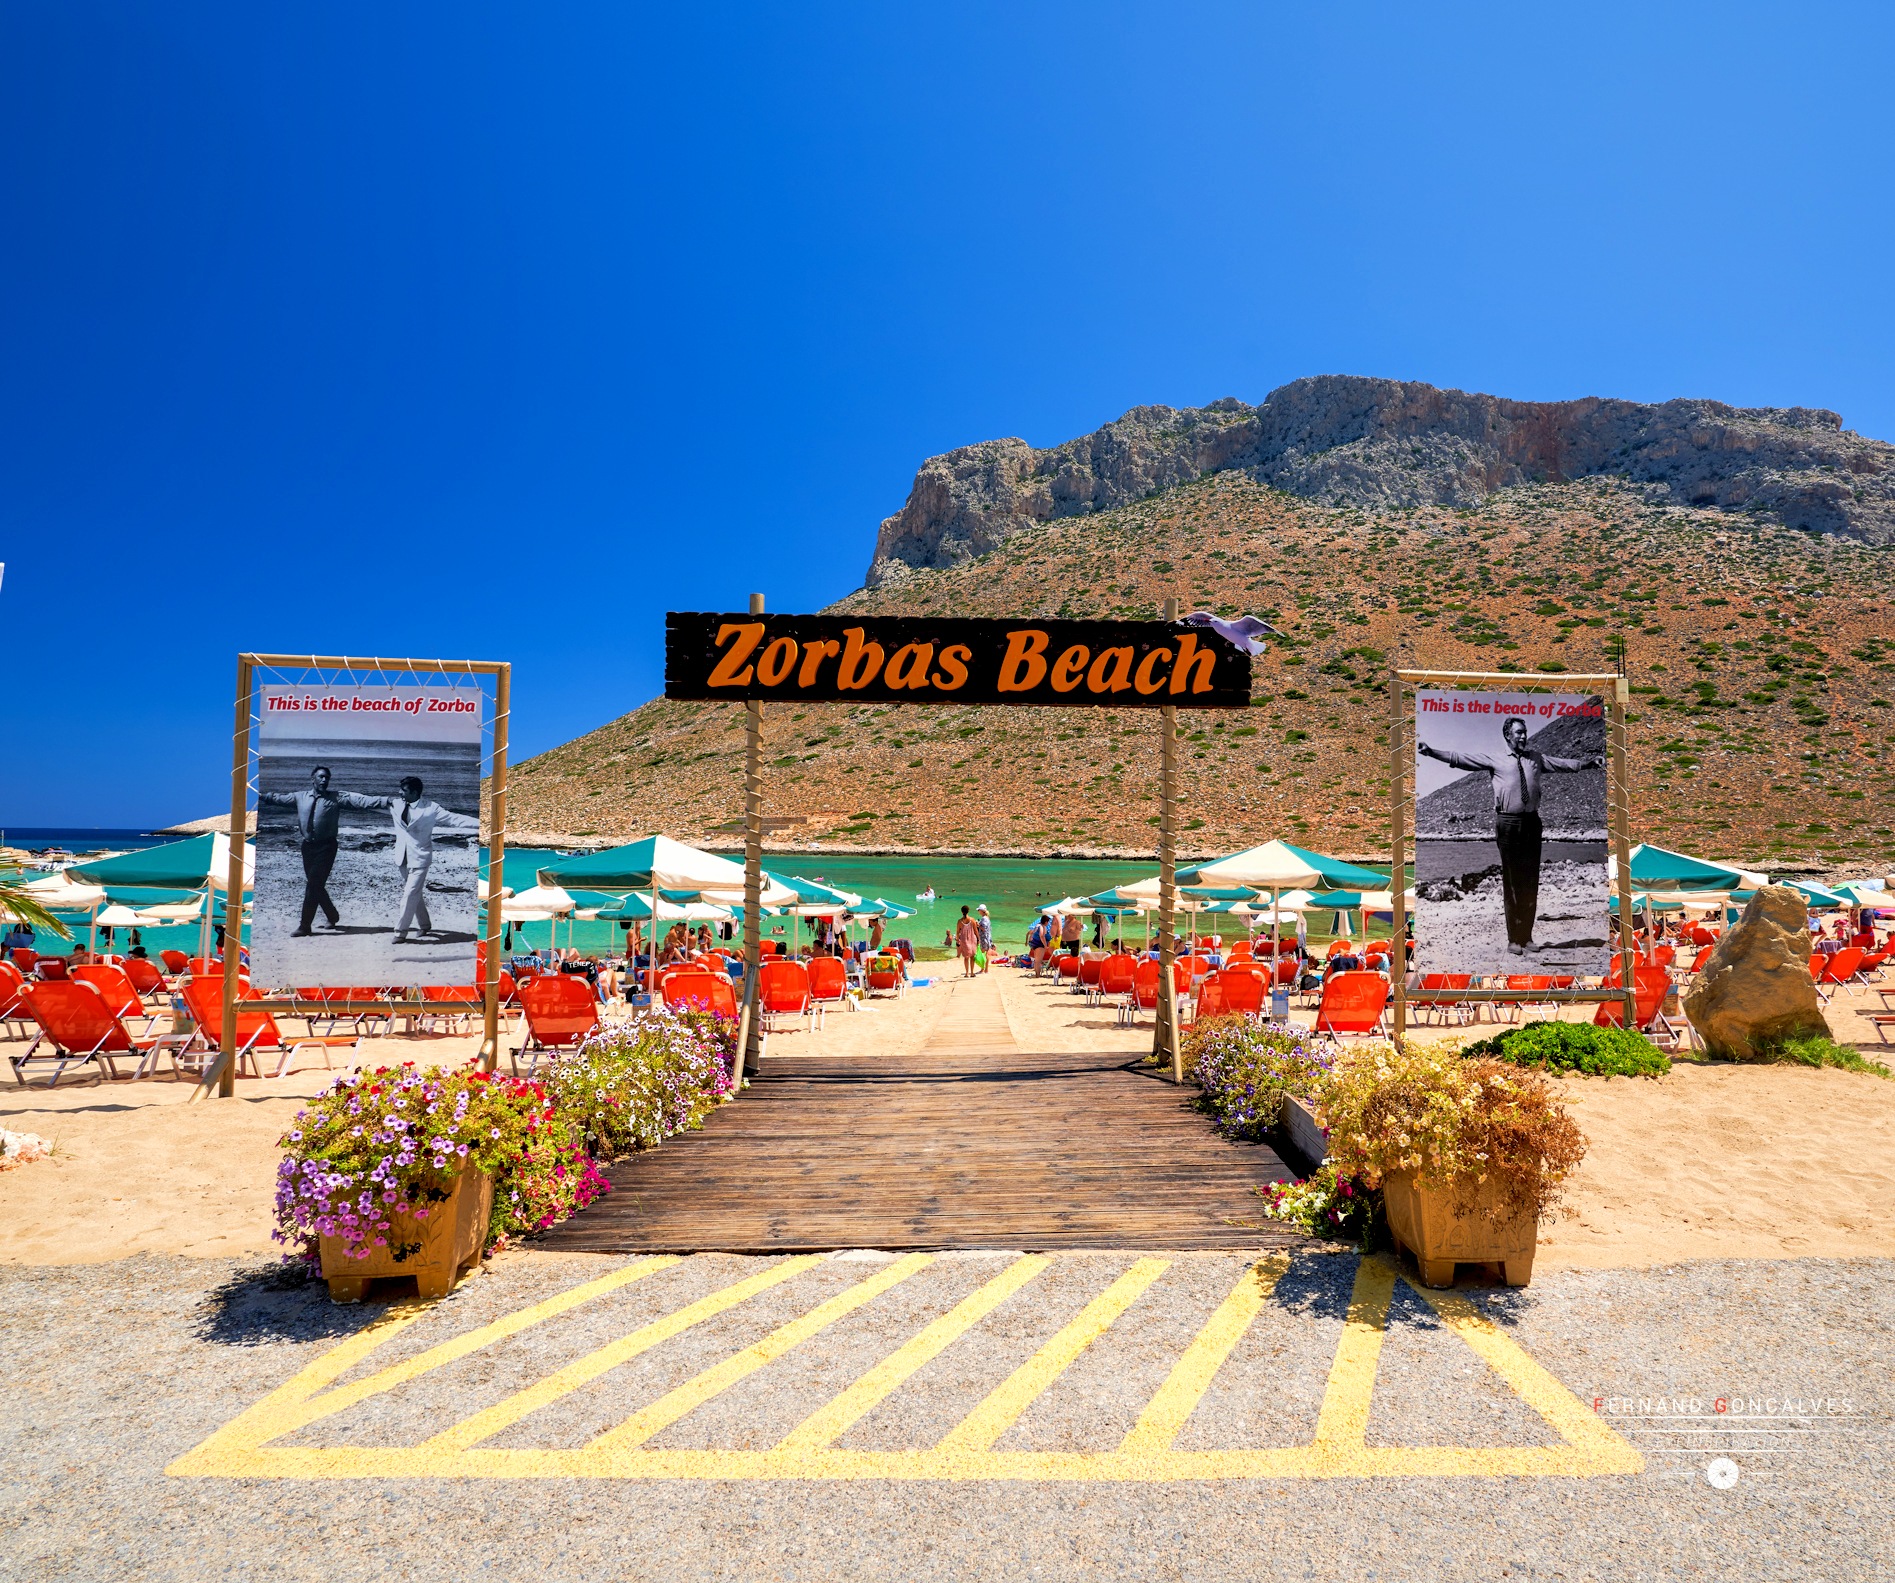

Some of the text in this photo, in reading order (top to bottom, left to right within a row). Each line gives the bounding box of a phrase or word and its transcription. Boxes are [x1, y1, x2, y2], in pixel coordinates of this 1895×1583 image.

[706, 622, 1217, 695] Zorbas Beach
[268, 695, 476, 715] This is the beach of Zorba
[1421, 698, 1602, 719] This is the beach of Zorba
